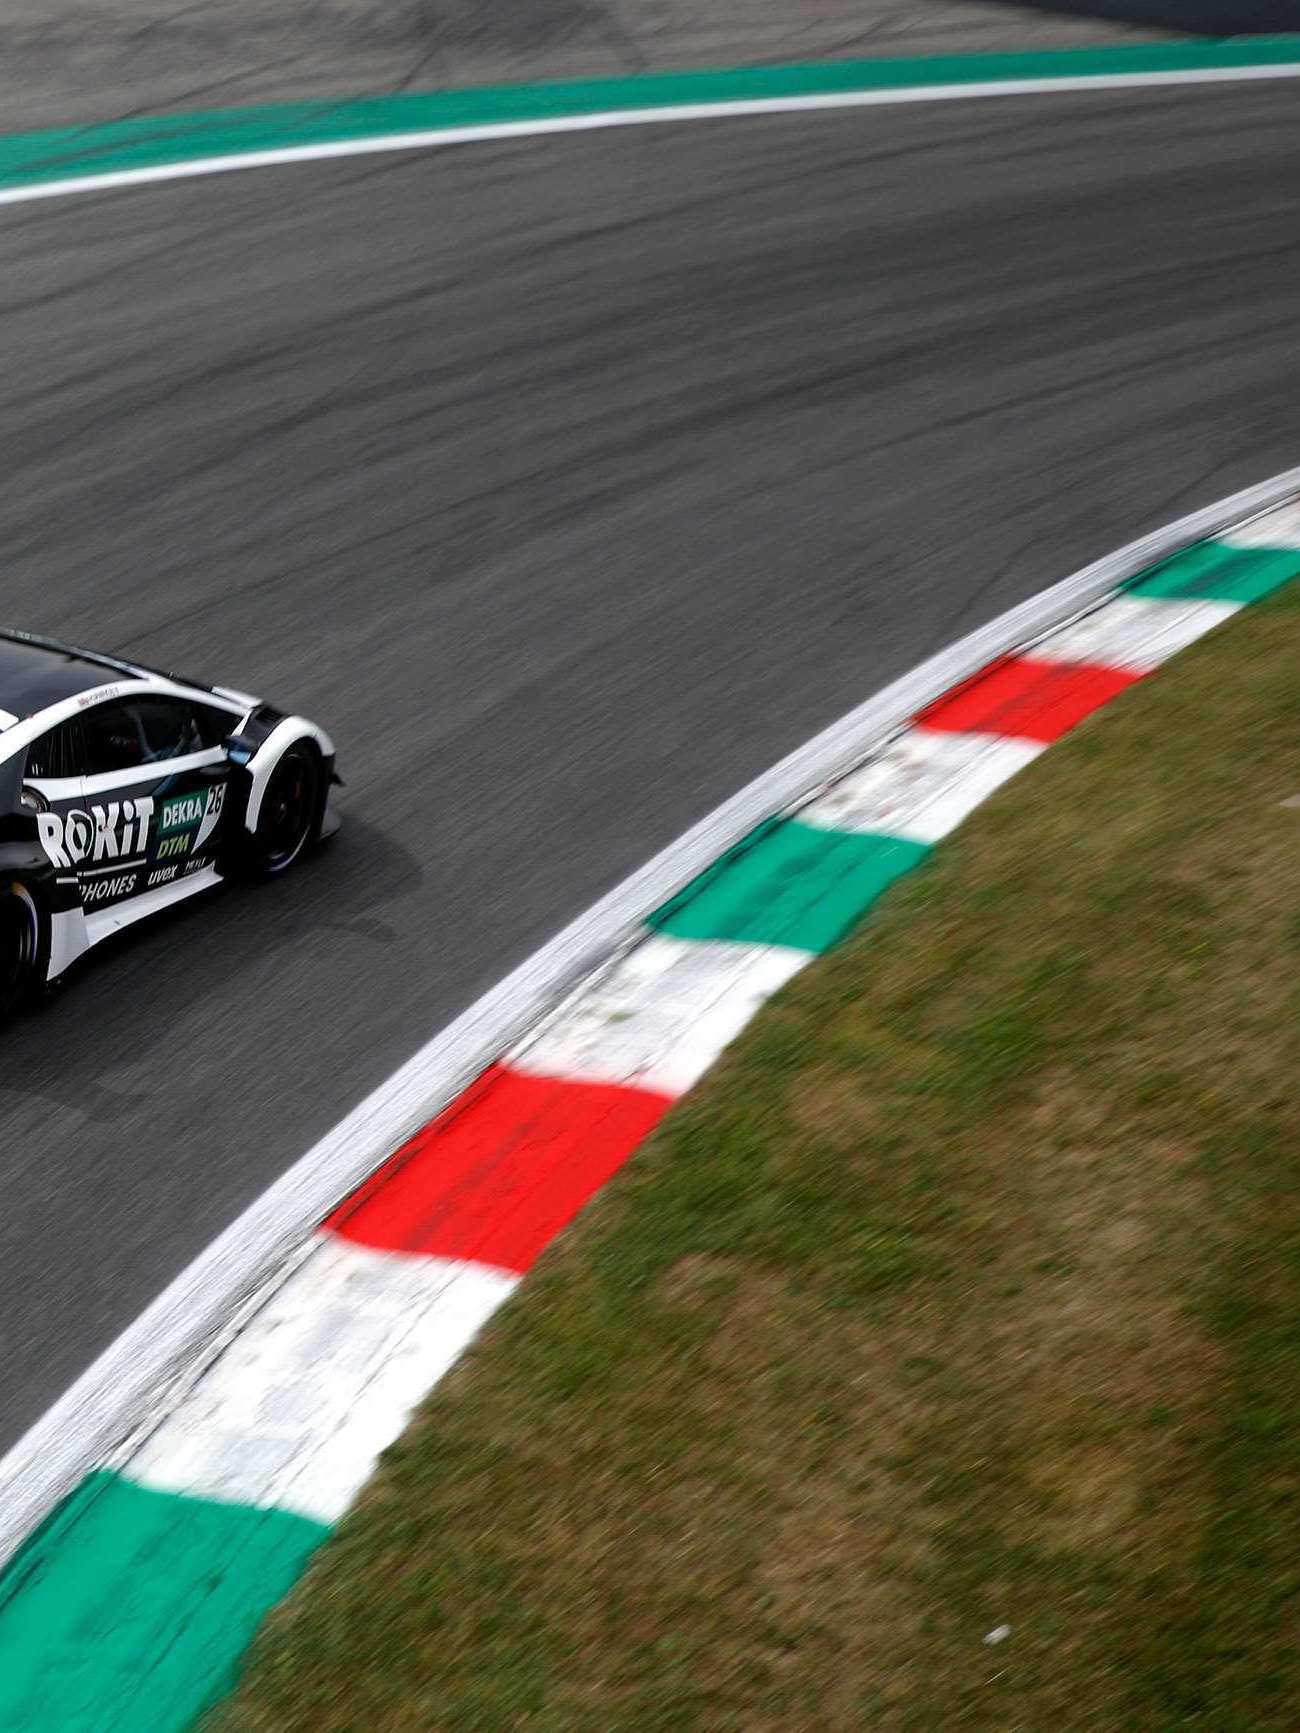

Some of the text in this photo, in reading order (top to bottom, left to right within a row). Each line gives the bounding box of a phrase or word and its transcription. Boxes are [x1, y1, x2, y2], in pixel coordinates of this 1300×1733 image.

[163, 798, 203, 829] DEKRA
[156, 833, 191, 860] DTM
[147, 864, 178, 886] uvex
